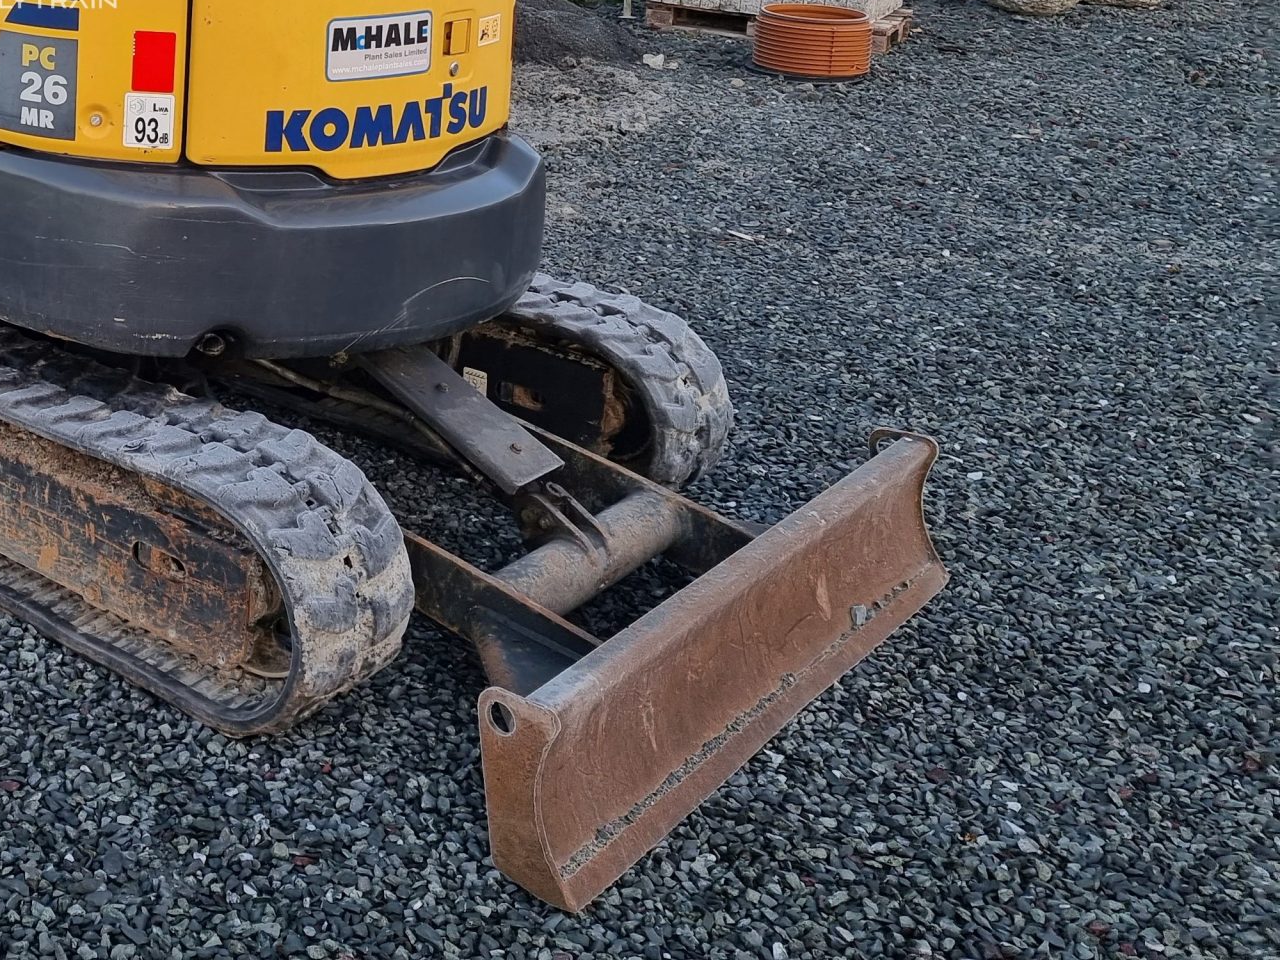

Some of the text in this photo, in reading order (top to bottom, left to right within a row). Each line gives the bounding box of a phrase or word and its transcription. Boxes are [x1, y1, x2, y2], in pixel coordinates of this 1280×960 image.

[331, 19, 429, 52] McHALE
[21, 43, 57, 71] PC
[364, 47, 428, 62] Plant Sales Limited
[20, 71, 68, 106] 26
[20, 106, 55, 130] MR
[134, 117, 169, 144] 93 dB
[264, 82, 488, 153] KOMATSU
